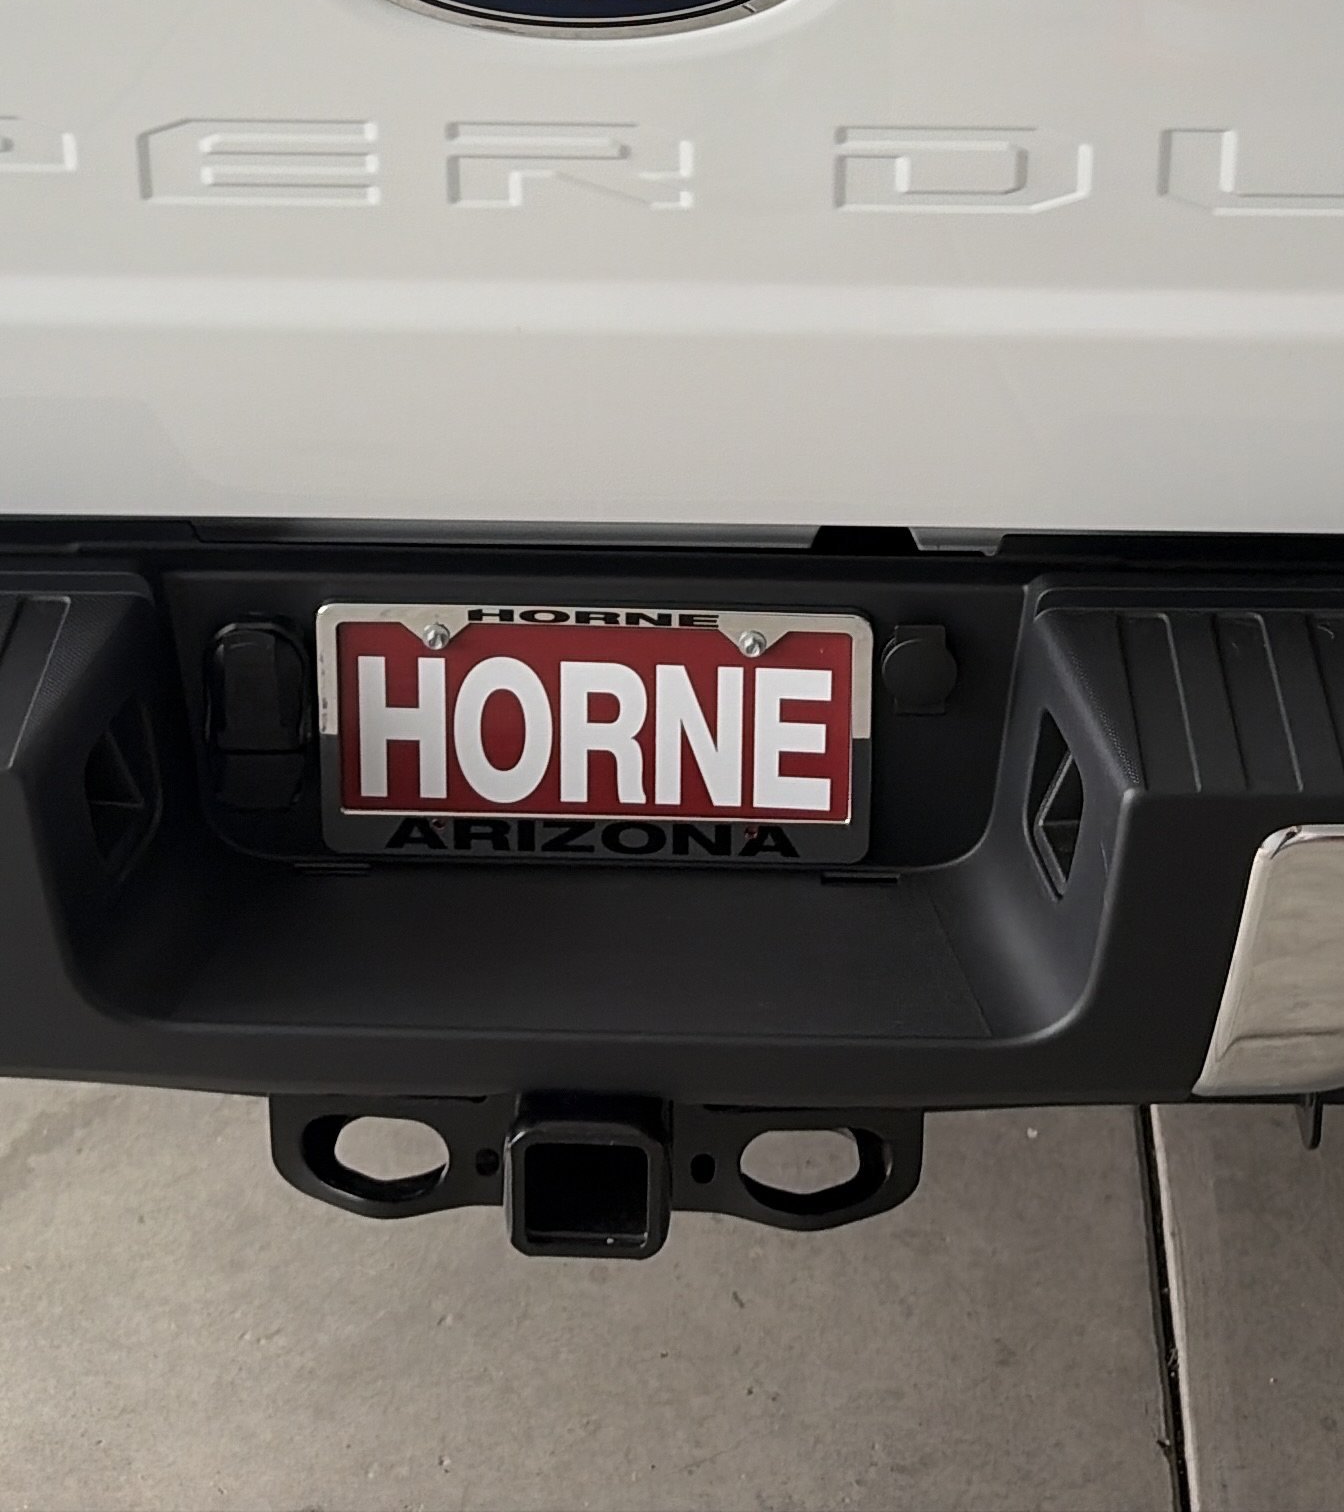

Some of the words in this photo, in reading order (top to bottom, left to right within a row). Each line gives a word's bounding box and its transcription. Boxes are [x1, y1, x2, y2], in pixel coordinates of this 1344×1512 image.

[467, 607, 720, 629] HORNE
[357, 655, 833, 812] HORNE
[384, 816, 801, 858] ARIZONA
